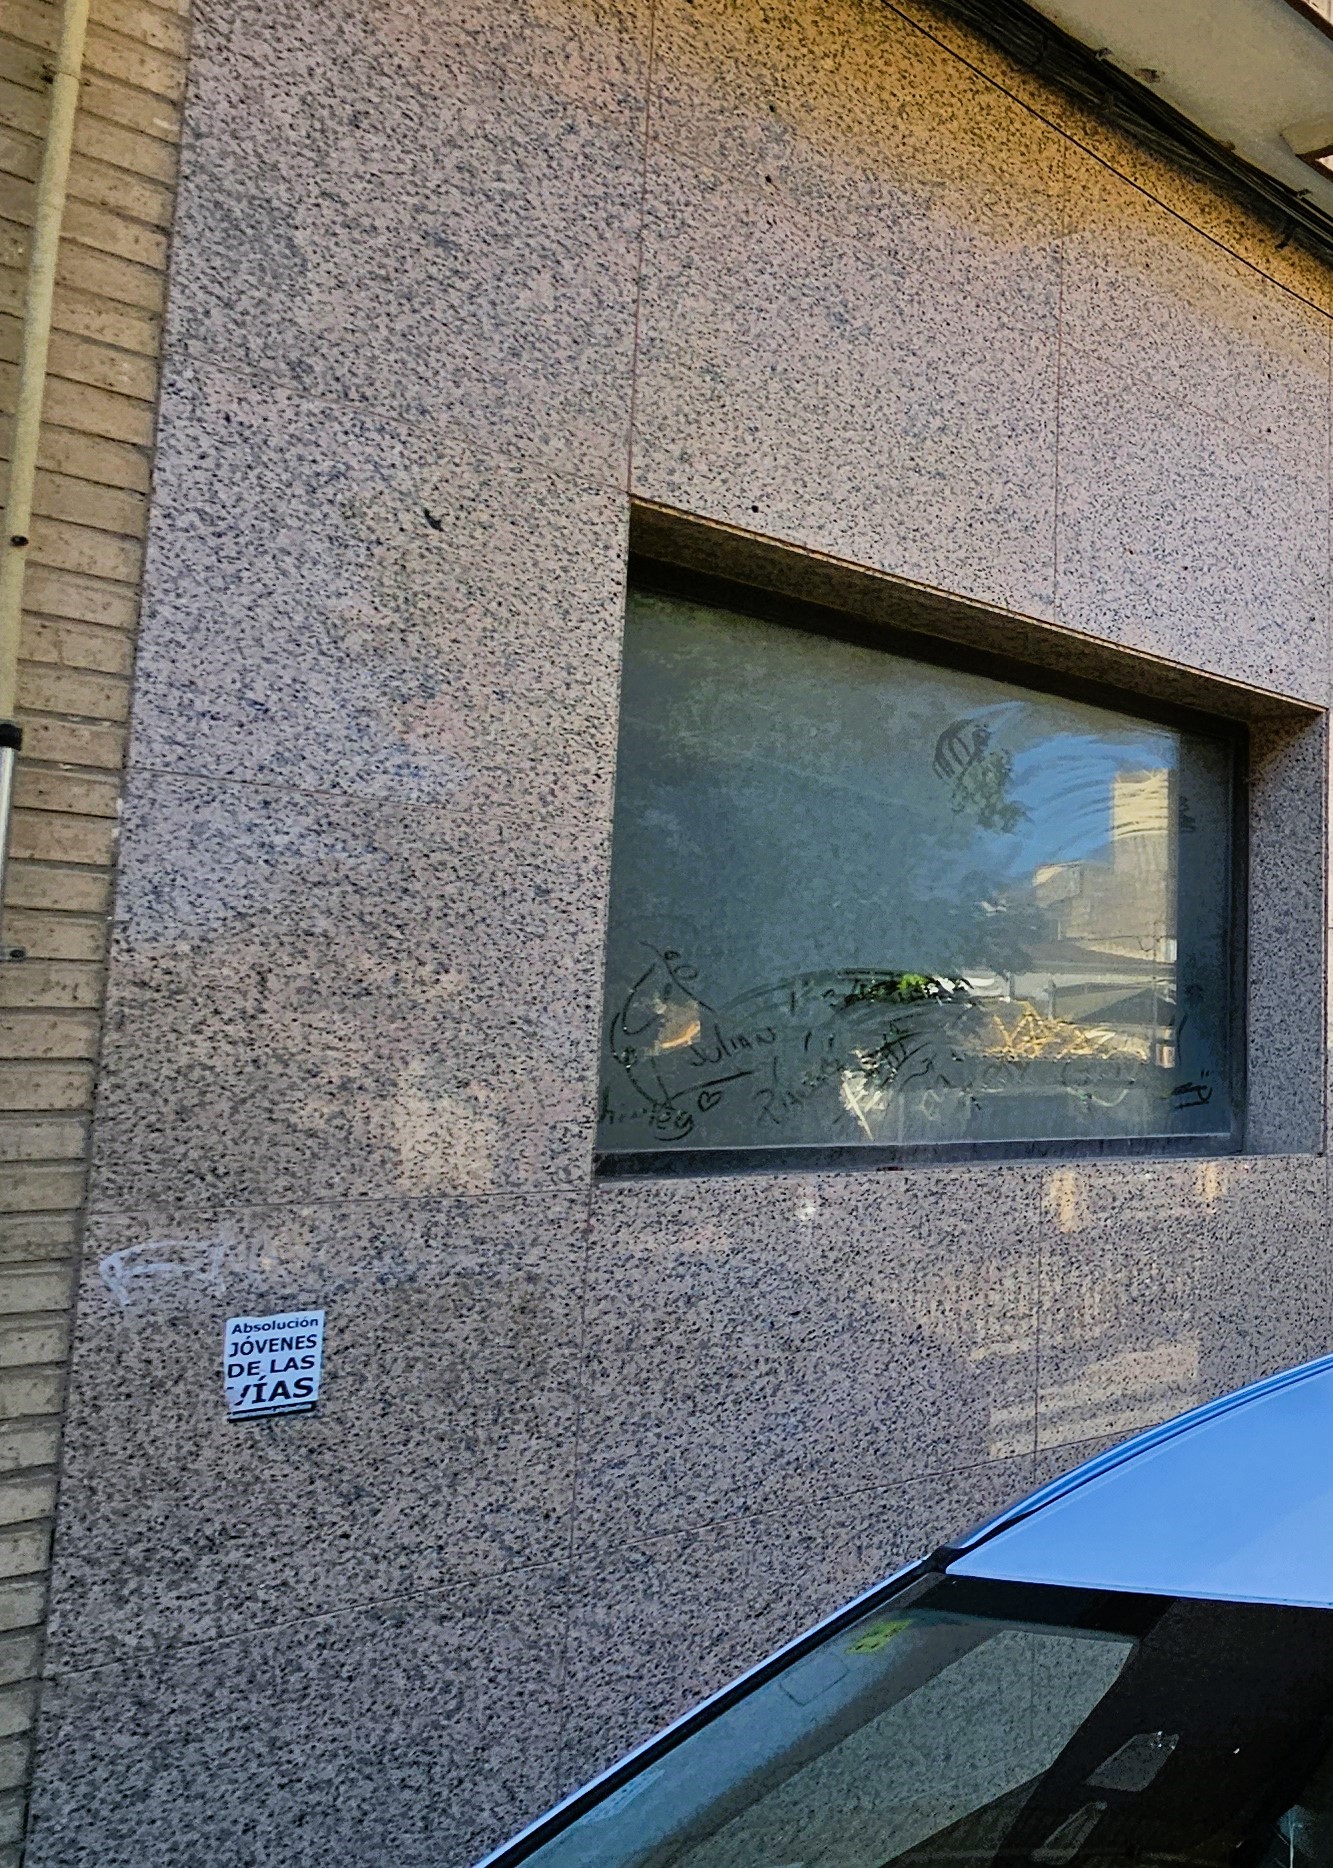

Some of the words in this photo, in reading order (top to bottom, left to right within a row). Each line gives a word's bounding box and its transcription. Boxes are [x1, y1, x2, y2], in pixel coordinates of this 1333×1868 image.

[231, 1316, 319, 1335] Absolución
[229, 1334, 318, 1358] JÓVENES
[227, 1361, 262, 1379] DE
[269, 1355, 316, 1374] LAS
